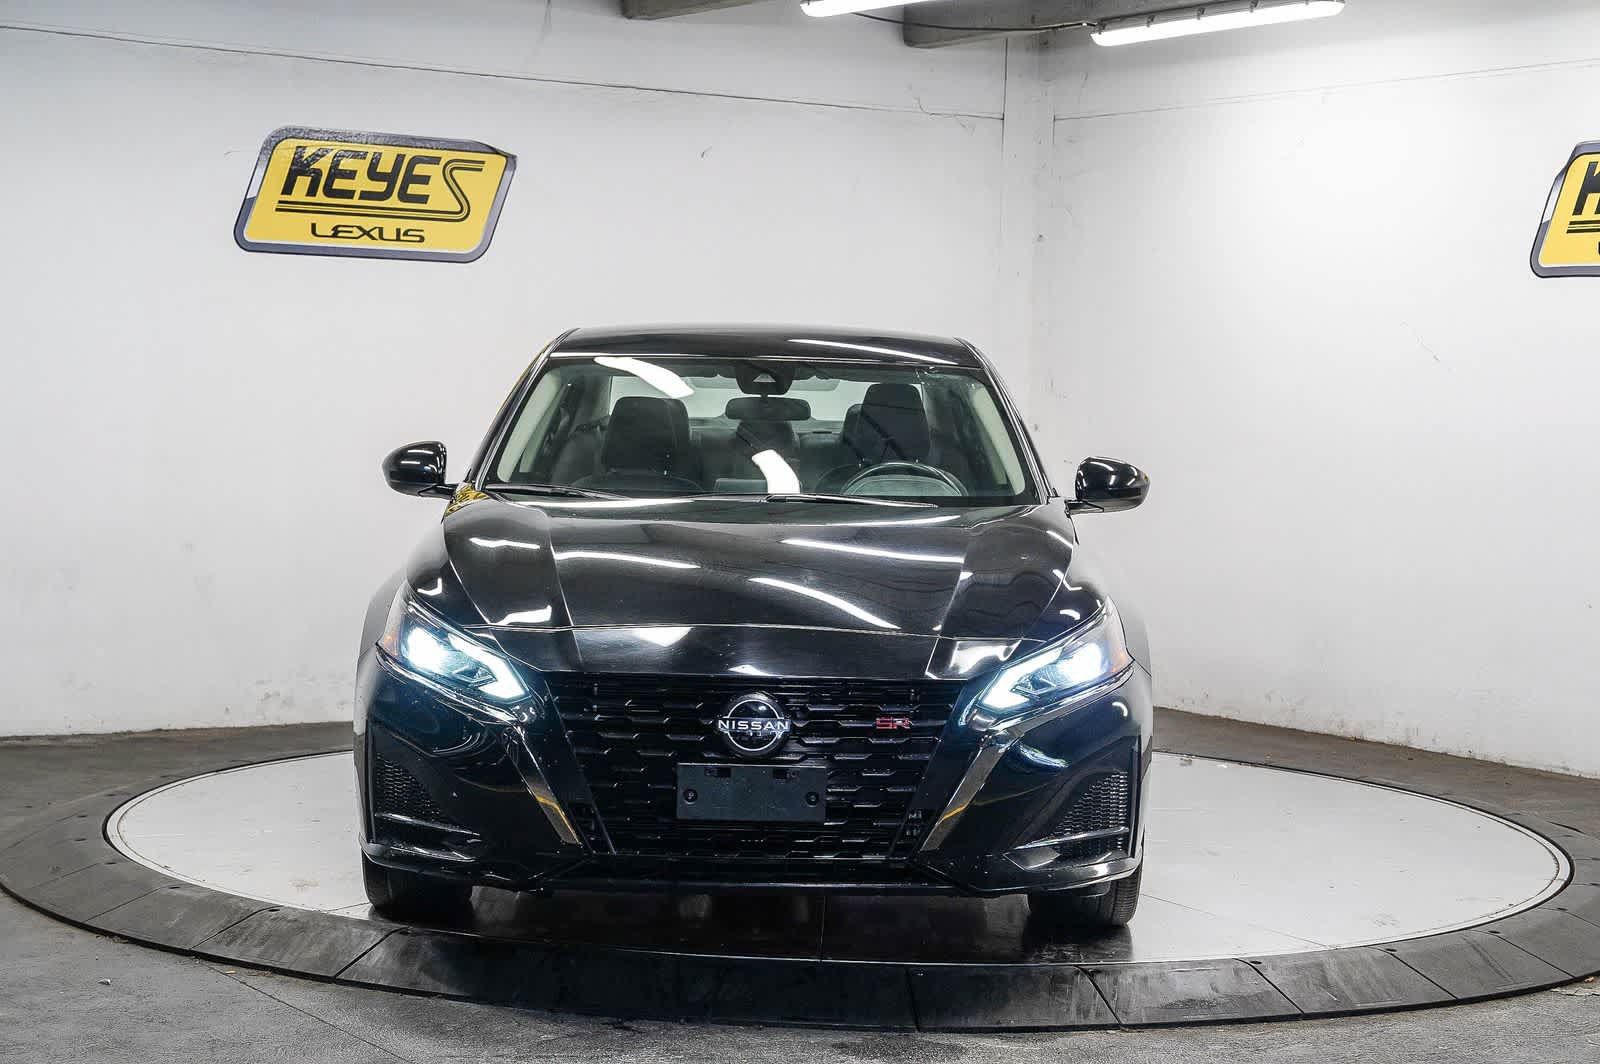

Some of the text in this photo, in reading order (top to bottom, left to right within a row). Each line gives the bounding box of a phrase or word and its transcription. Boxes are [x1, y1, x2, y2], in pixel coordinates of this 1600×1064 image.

[280, 145, 485, 222] KEYES
[311, 222, 425, 243] LEXUS
[718, 719, 789, 731] NISSAN
[875, 716, 911, 729] SR
